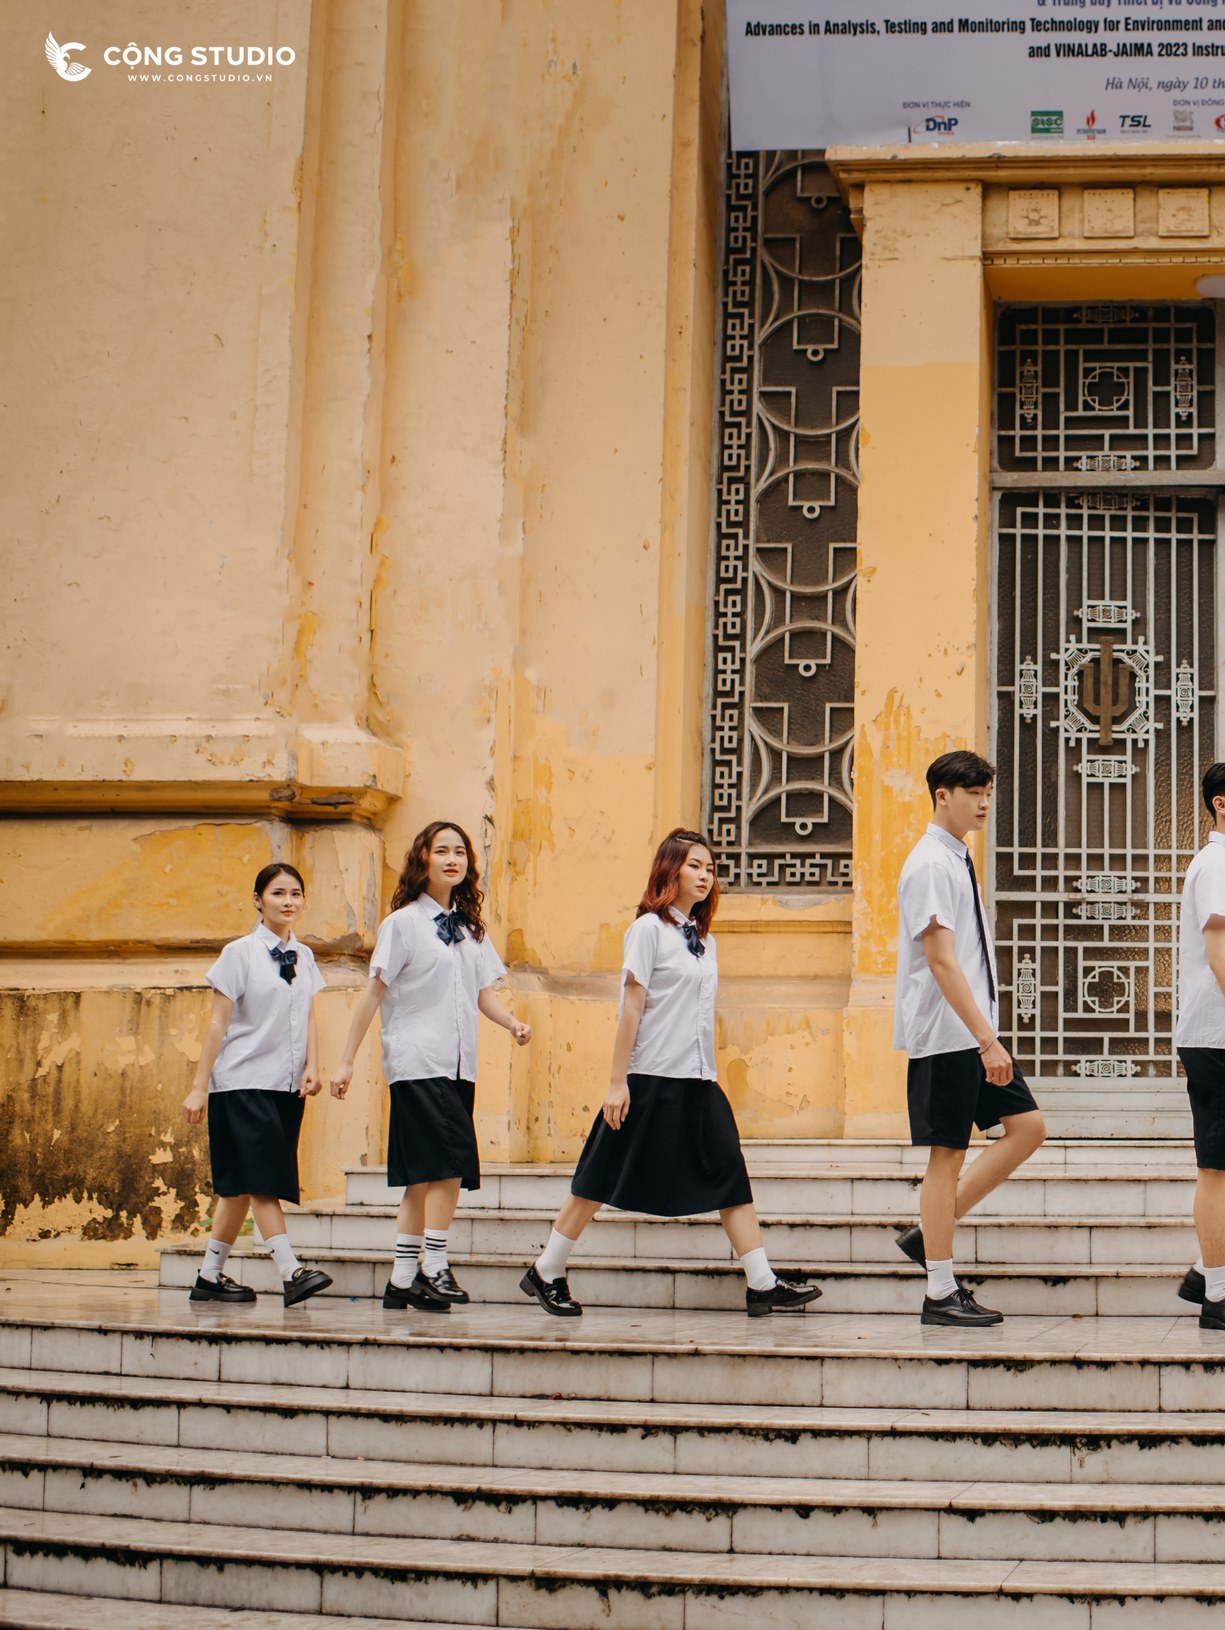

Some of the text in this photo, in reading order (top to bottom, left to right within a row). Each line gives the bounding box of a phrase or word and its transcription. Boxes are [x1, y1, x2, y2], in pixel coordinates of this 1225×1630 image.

[745, 21, 805, 36] Advances
[809, 20, 820, 35] in
[824, 19, 880, 37] Analysis,
[883, 19, 927, 37] Testing
[931, 18, 954, 34] and
[958, 17, 1026, 36] Monitoring
[1029, 17, 1100, 35] Technology
[1103, 17, 1121, 32] for
[1124, 16, 1203, 32] Environment
[1028, 43, 1051, 58] and
[1055, 42, 1154, 58] VINALAB-JAIMA
[1157, 42, 1188, 57] 2023
[1105, 75, 1123, 91] Hà
[1127, 76, 1152, 93] Nội,
[1157, 76, 1189, 94] ngày
[1193, 77, 1208, 90] 10
[925, 117, 959, 132] DnP
[1119, 115, 1152, 128] TSL
